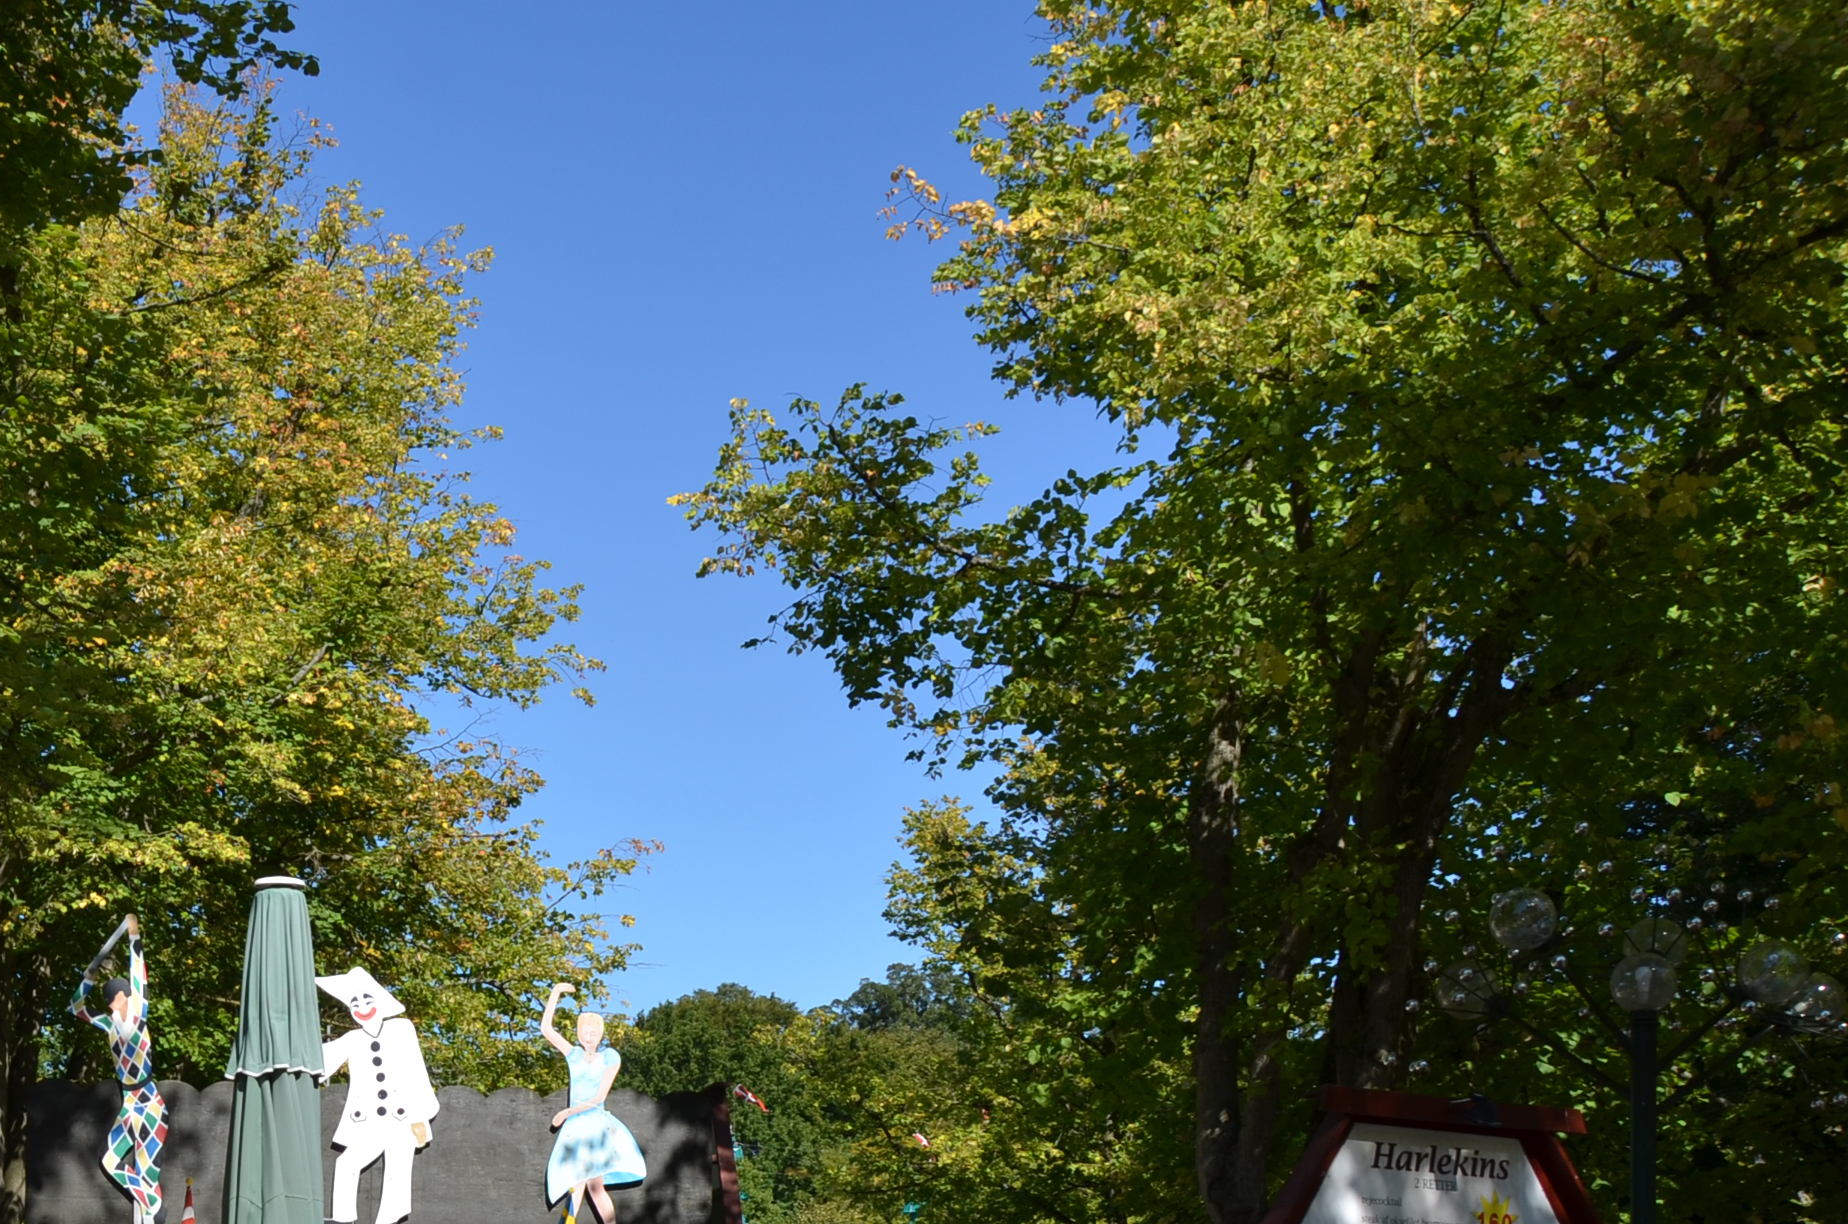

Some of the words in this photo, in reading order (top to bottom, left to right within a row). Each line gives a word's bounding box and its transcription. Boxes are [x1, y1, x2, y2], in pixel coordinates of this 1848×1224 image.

[1371, 1141, 1510, 1180] Harlekins
[1414, 1177, 1420, 1188] 2
[1422, 1179, 1458, 1191] RETTER
[1362, 1215, 1380, 1224] steak
